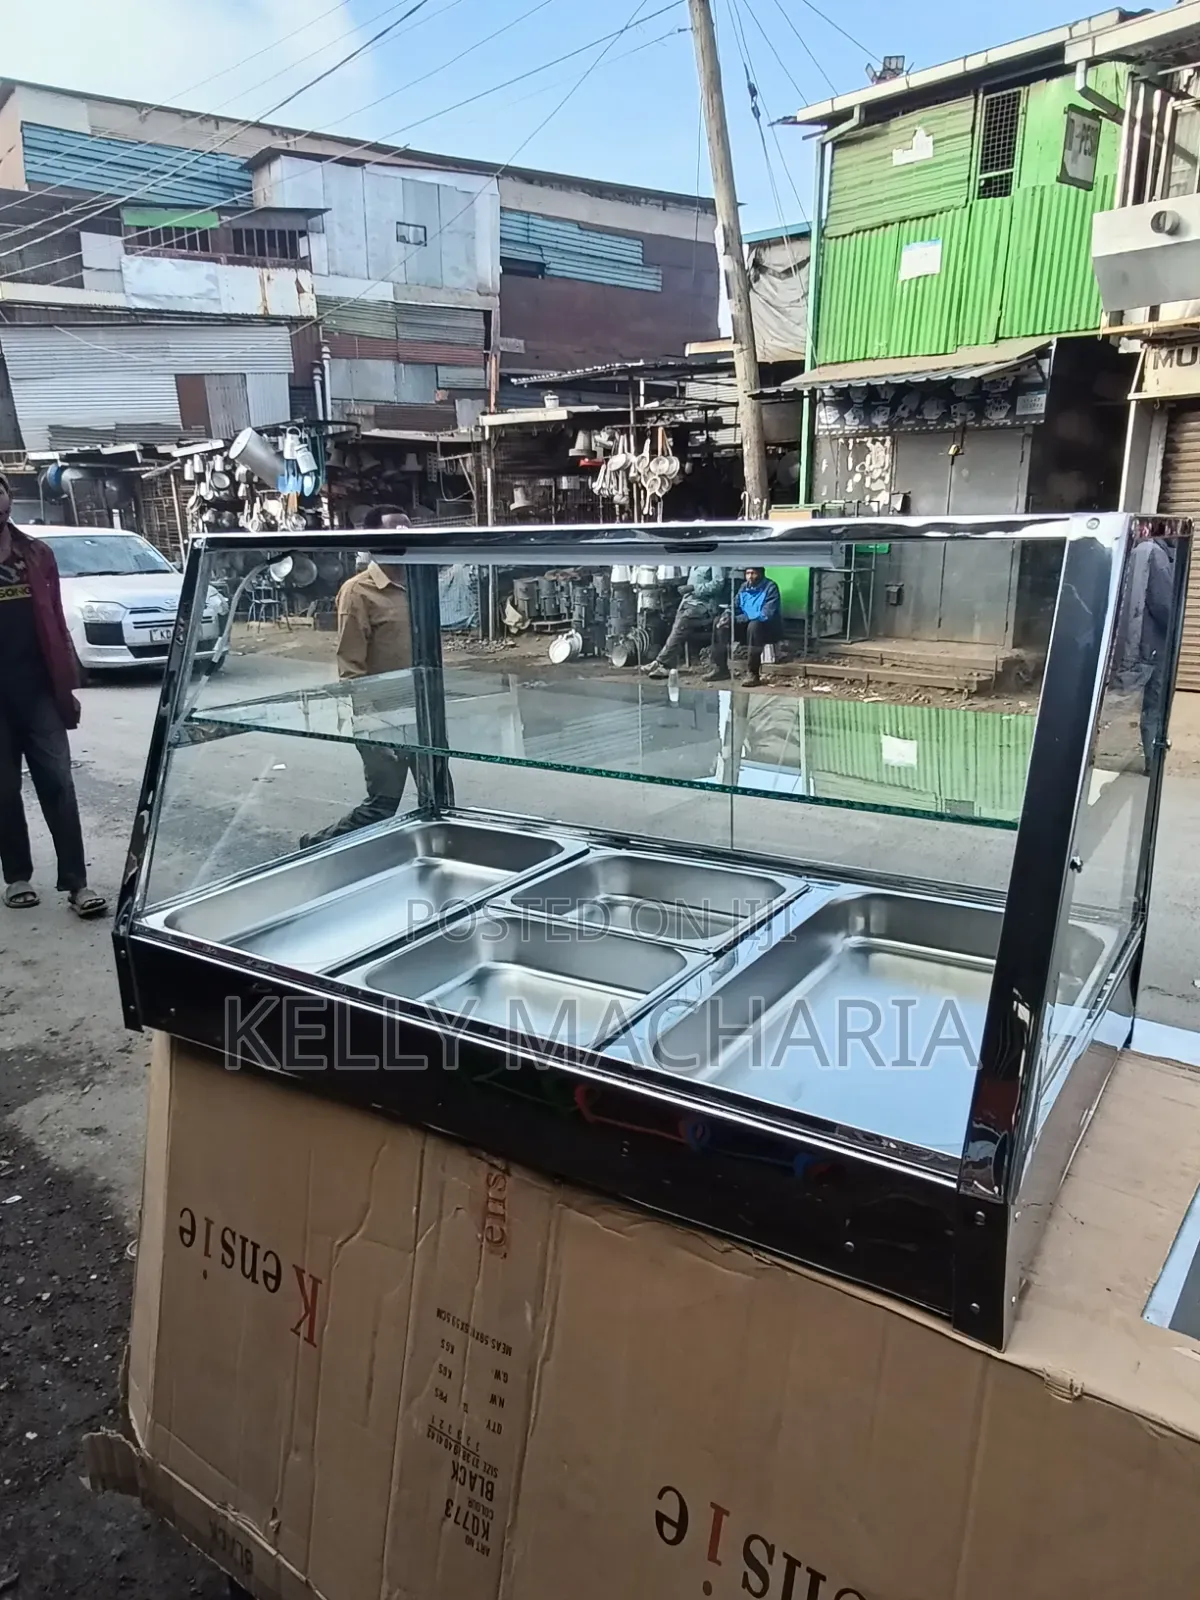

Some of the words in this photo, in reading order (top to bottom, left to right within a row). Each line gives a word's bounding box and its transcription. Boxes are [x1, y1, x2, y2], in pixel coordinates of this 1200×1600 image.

[1153, 346, 1200, 370] MU
[179, 1207, 323, 1348] Kensie
[451, 1460, 495, 1502] BLACK
